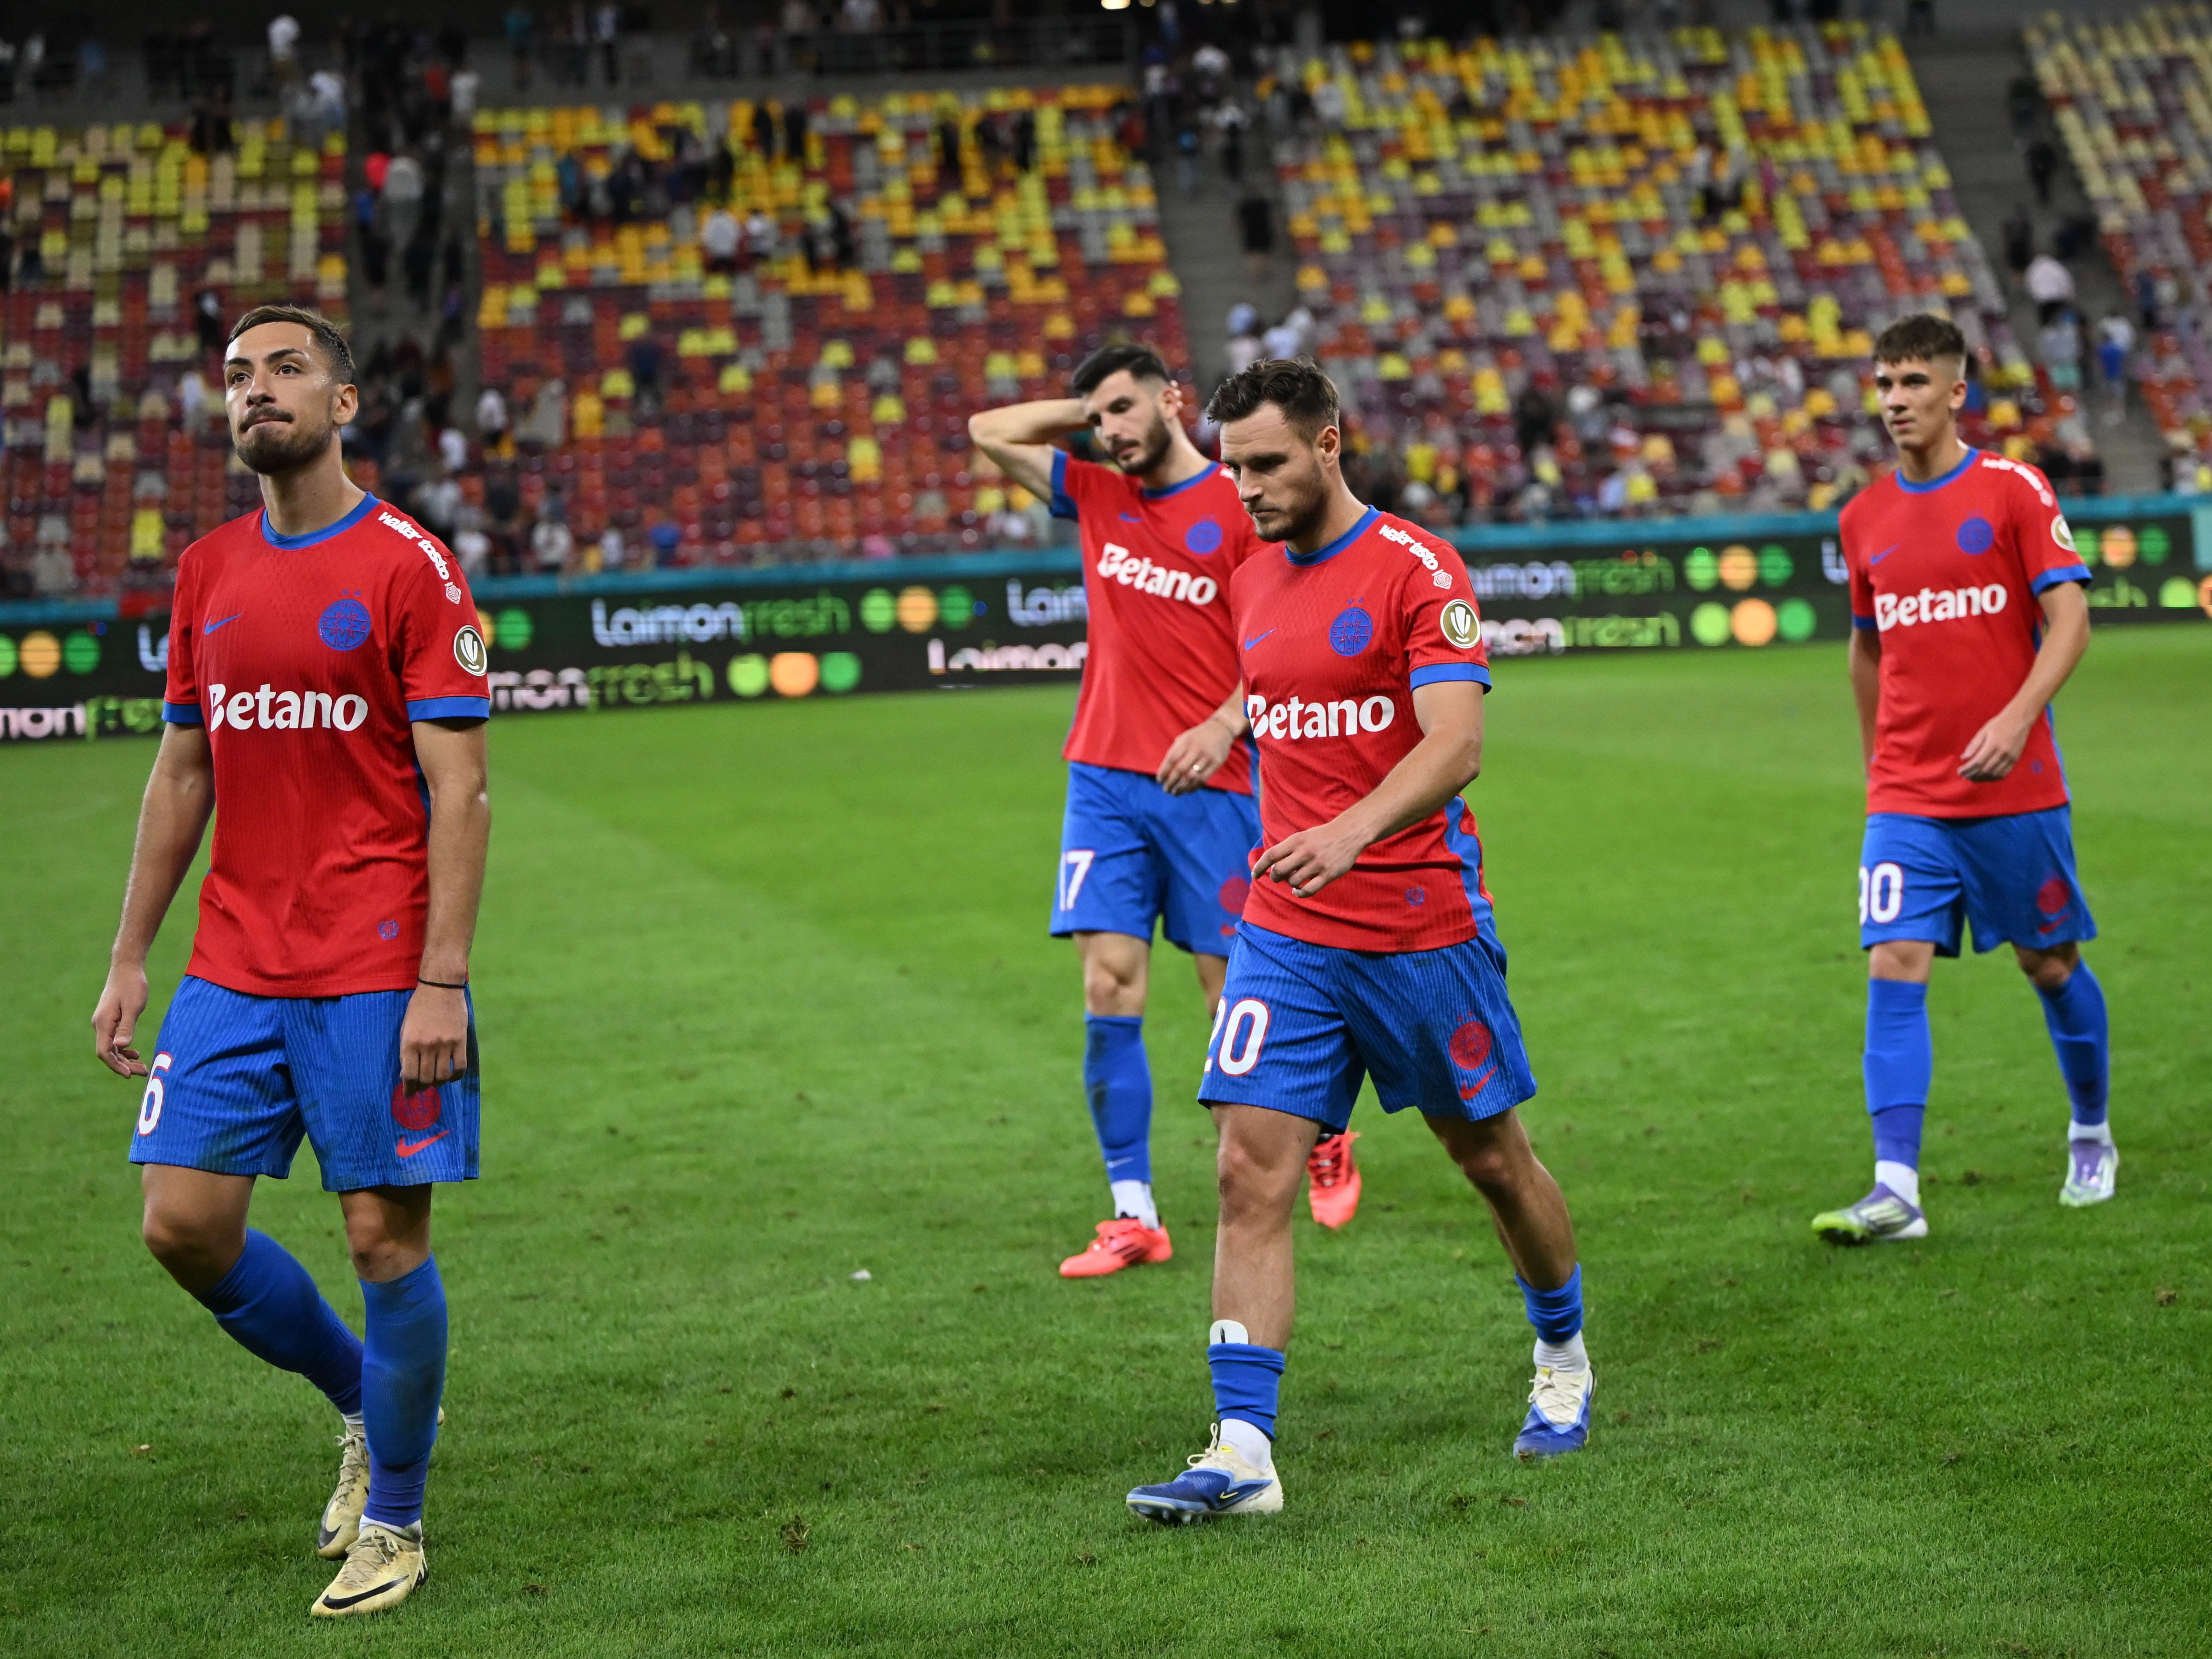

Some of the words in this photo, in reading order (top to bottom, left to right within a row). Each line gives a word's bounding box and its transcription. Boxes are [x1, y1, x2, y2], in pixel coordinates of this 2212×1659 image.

[378, 512, 423, 539] walter
[418, 539, 449, 580] tosto
[1097, 542, 1218, 606] Betano
[1874, 584, 2008, 632] Betano
[209, 683, 369, 732] Betano
[1247, 694, 1395, 739] Betano
